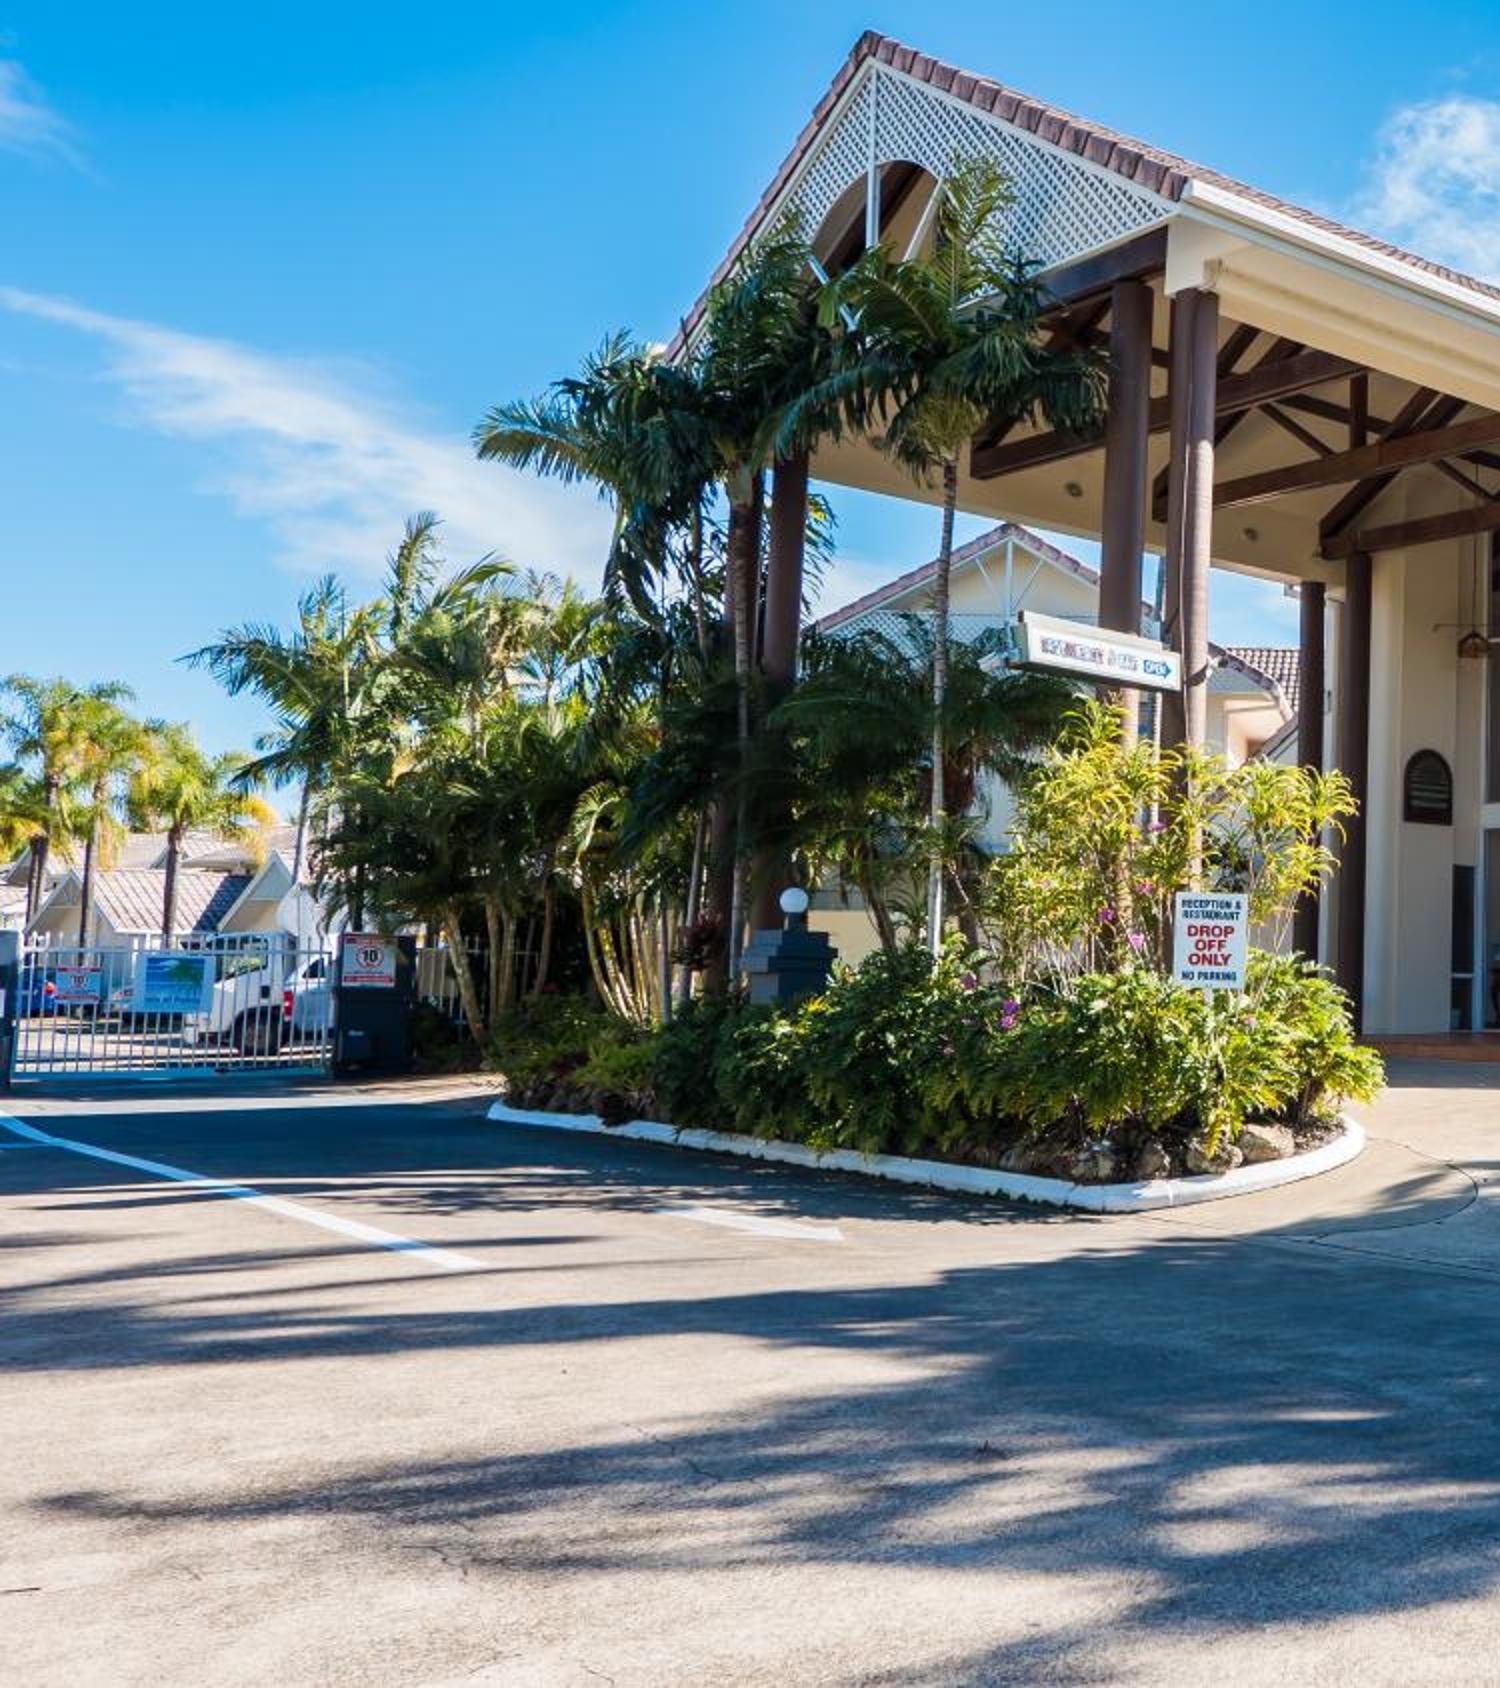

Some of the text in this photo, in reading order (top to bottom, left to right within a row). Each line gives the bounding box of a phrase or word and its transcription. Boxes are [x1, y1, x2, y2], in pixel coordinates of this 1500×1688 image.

[1181, 899, 1242, 910] RECEPTION &
[1183, 909, 1241, 921] RESTAURANT
[1187, 925, 1235, 938] DROP
[1195, 939, 1227, 952] OFF
[362, 949, 379, 962] 10
[1188, 953, 1232, 966] ONLY
[1181, 971, 1237, 982] NO PARKING
